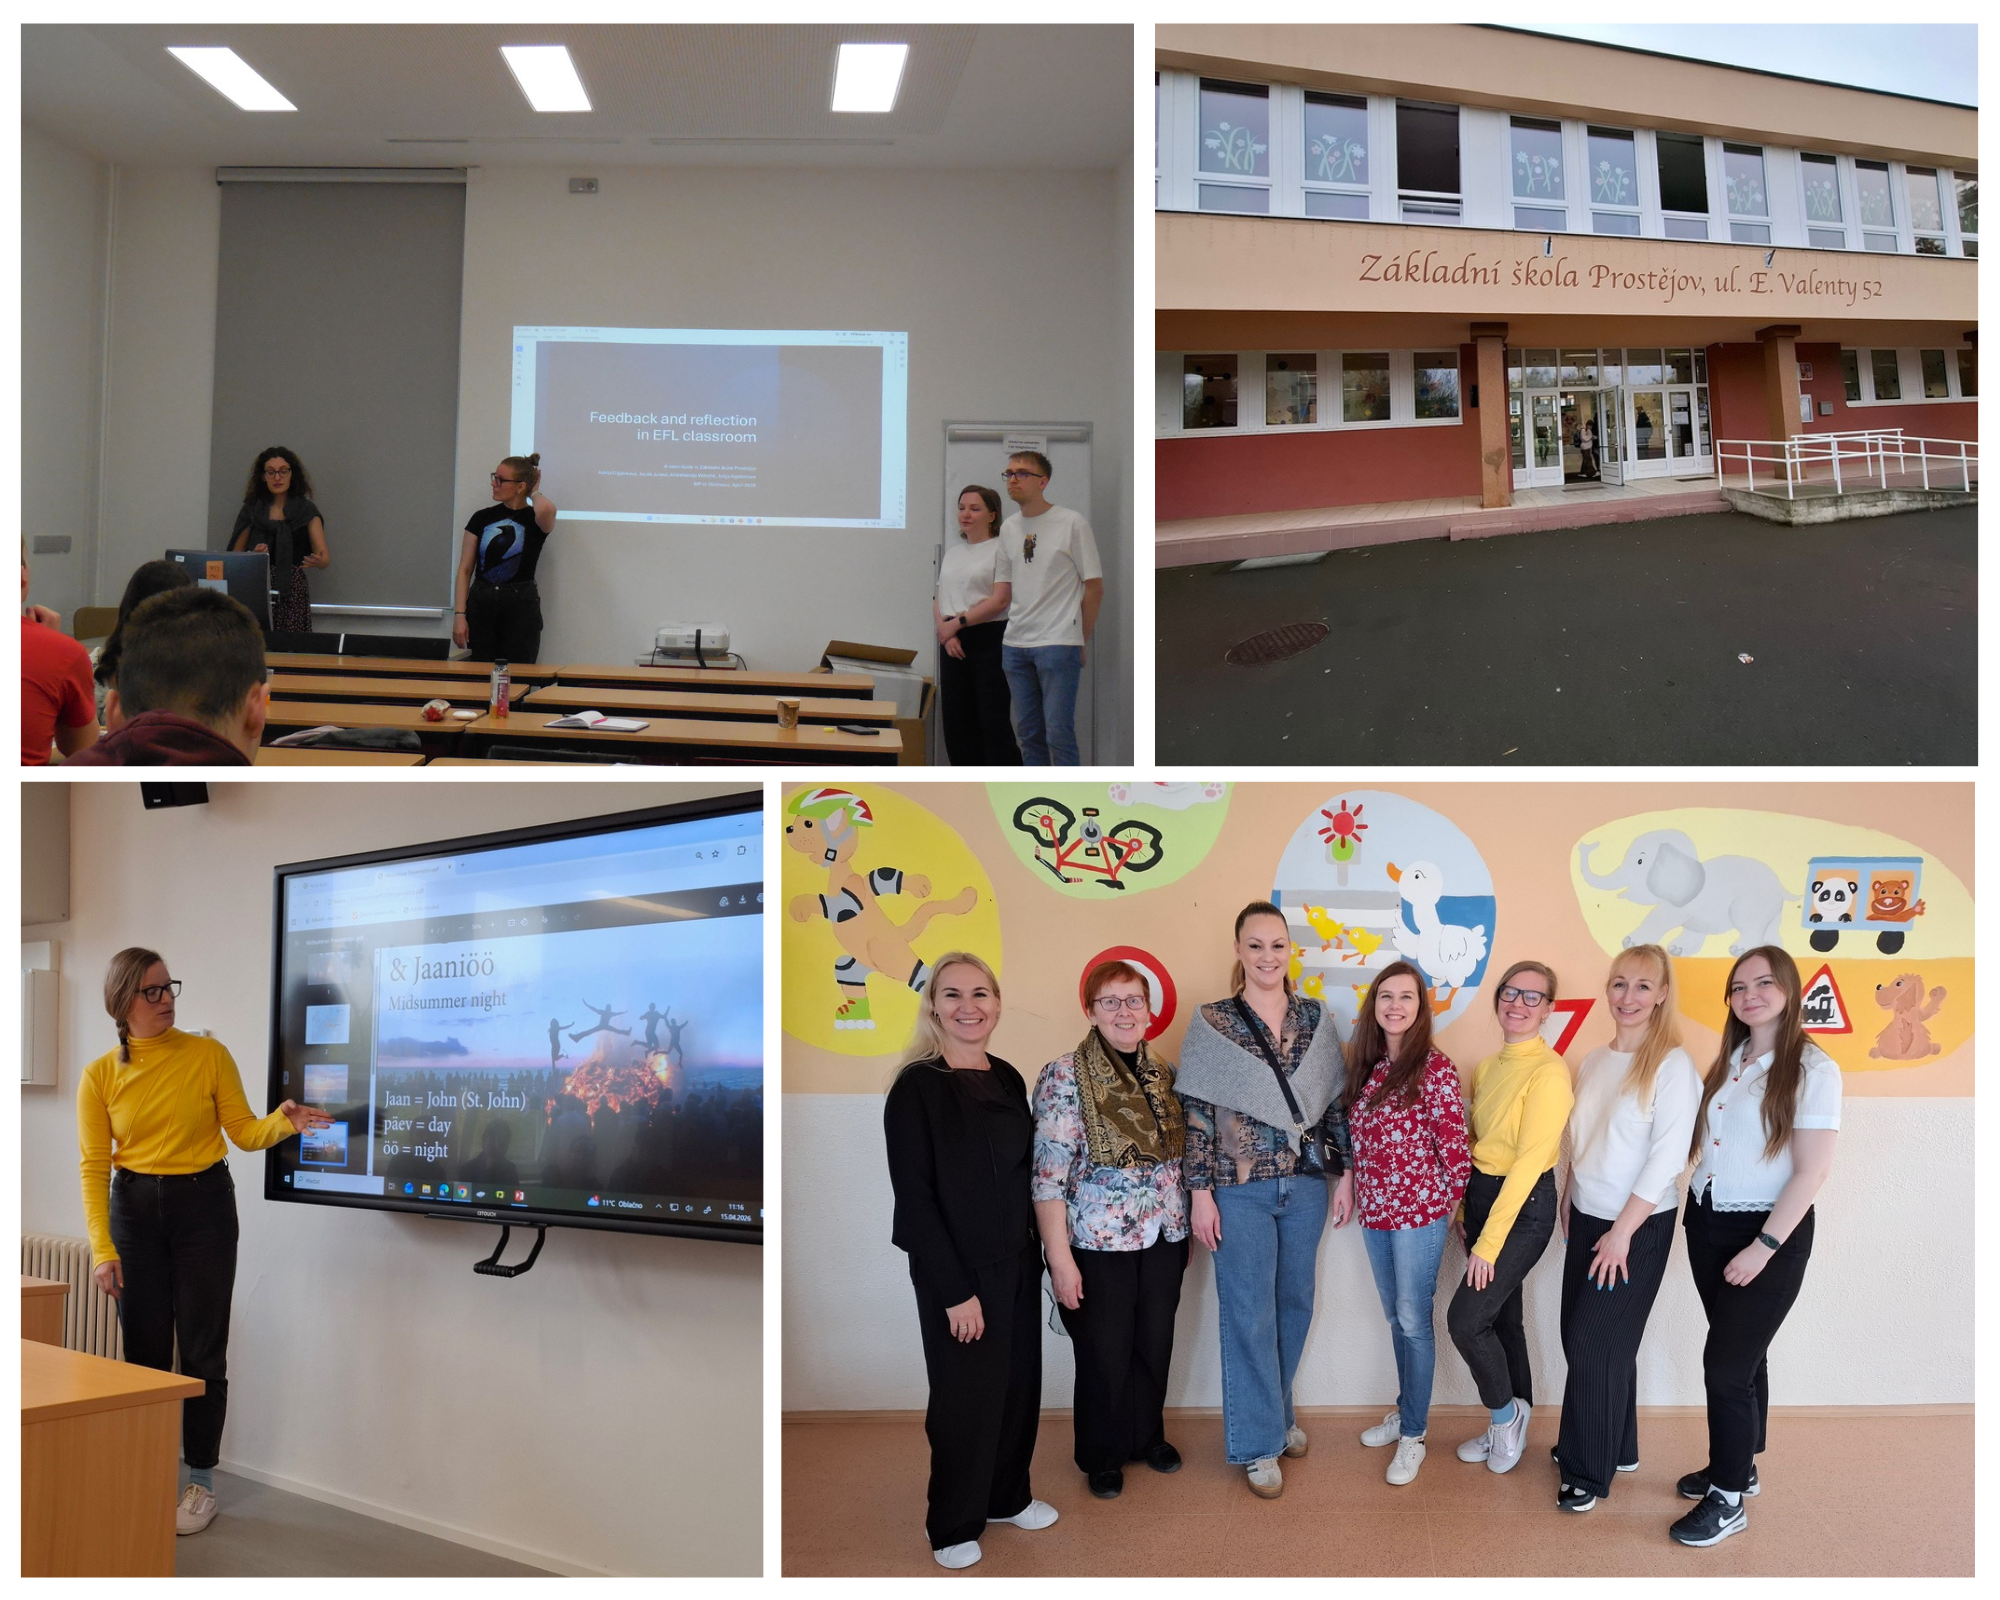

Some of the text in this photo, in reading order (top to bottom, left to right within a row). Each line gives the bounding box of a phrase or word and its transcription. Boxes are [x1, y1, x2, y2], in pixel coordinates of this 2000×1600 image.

[1359, 249, 1883, 307] Základní škola Prostějov, ul. E. Valenty 52
[590, 411, 757, 427] Feedback and reflection
[637, 428, 757, 443] in EFL classroom
[389, 951, 495, 986] & Jaaniöö
[388, 989, 507, 1012] Midsummer night
[384, 1090, 411, 1109] Jaan
[426, 1090, 457, 1109] John
[461, 1090, 483, 1111] (St.
[487, 1090, 526, 1112] John)
[383, 1116, 413, 1135] päev
[428, 1115, 452, 1137] day
[382, 1140, 399, 1155] öö
[414, 1141, 449, 1162] night
[618, 1200, 643, 1210] Oblačno
[728, 1203, 745, 1211] 11:16
[720, 1213, 752, 1222] 15.04.2026
